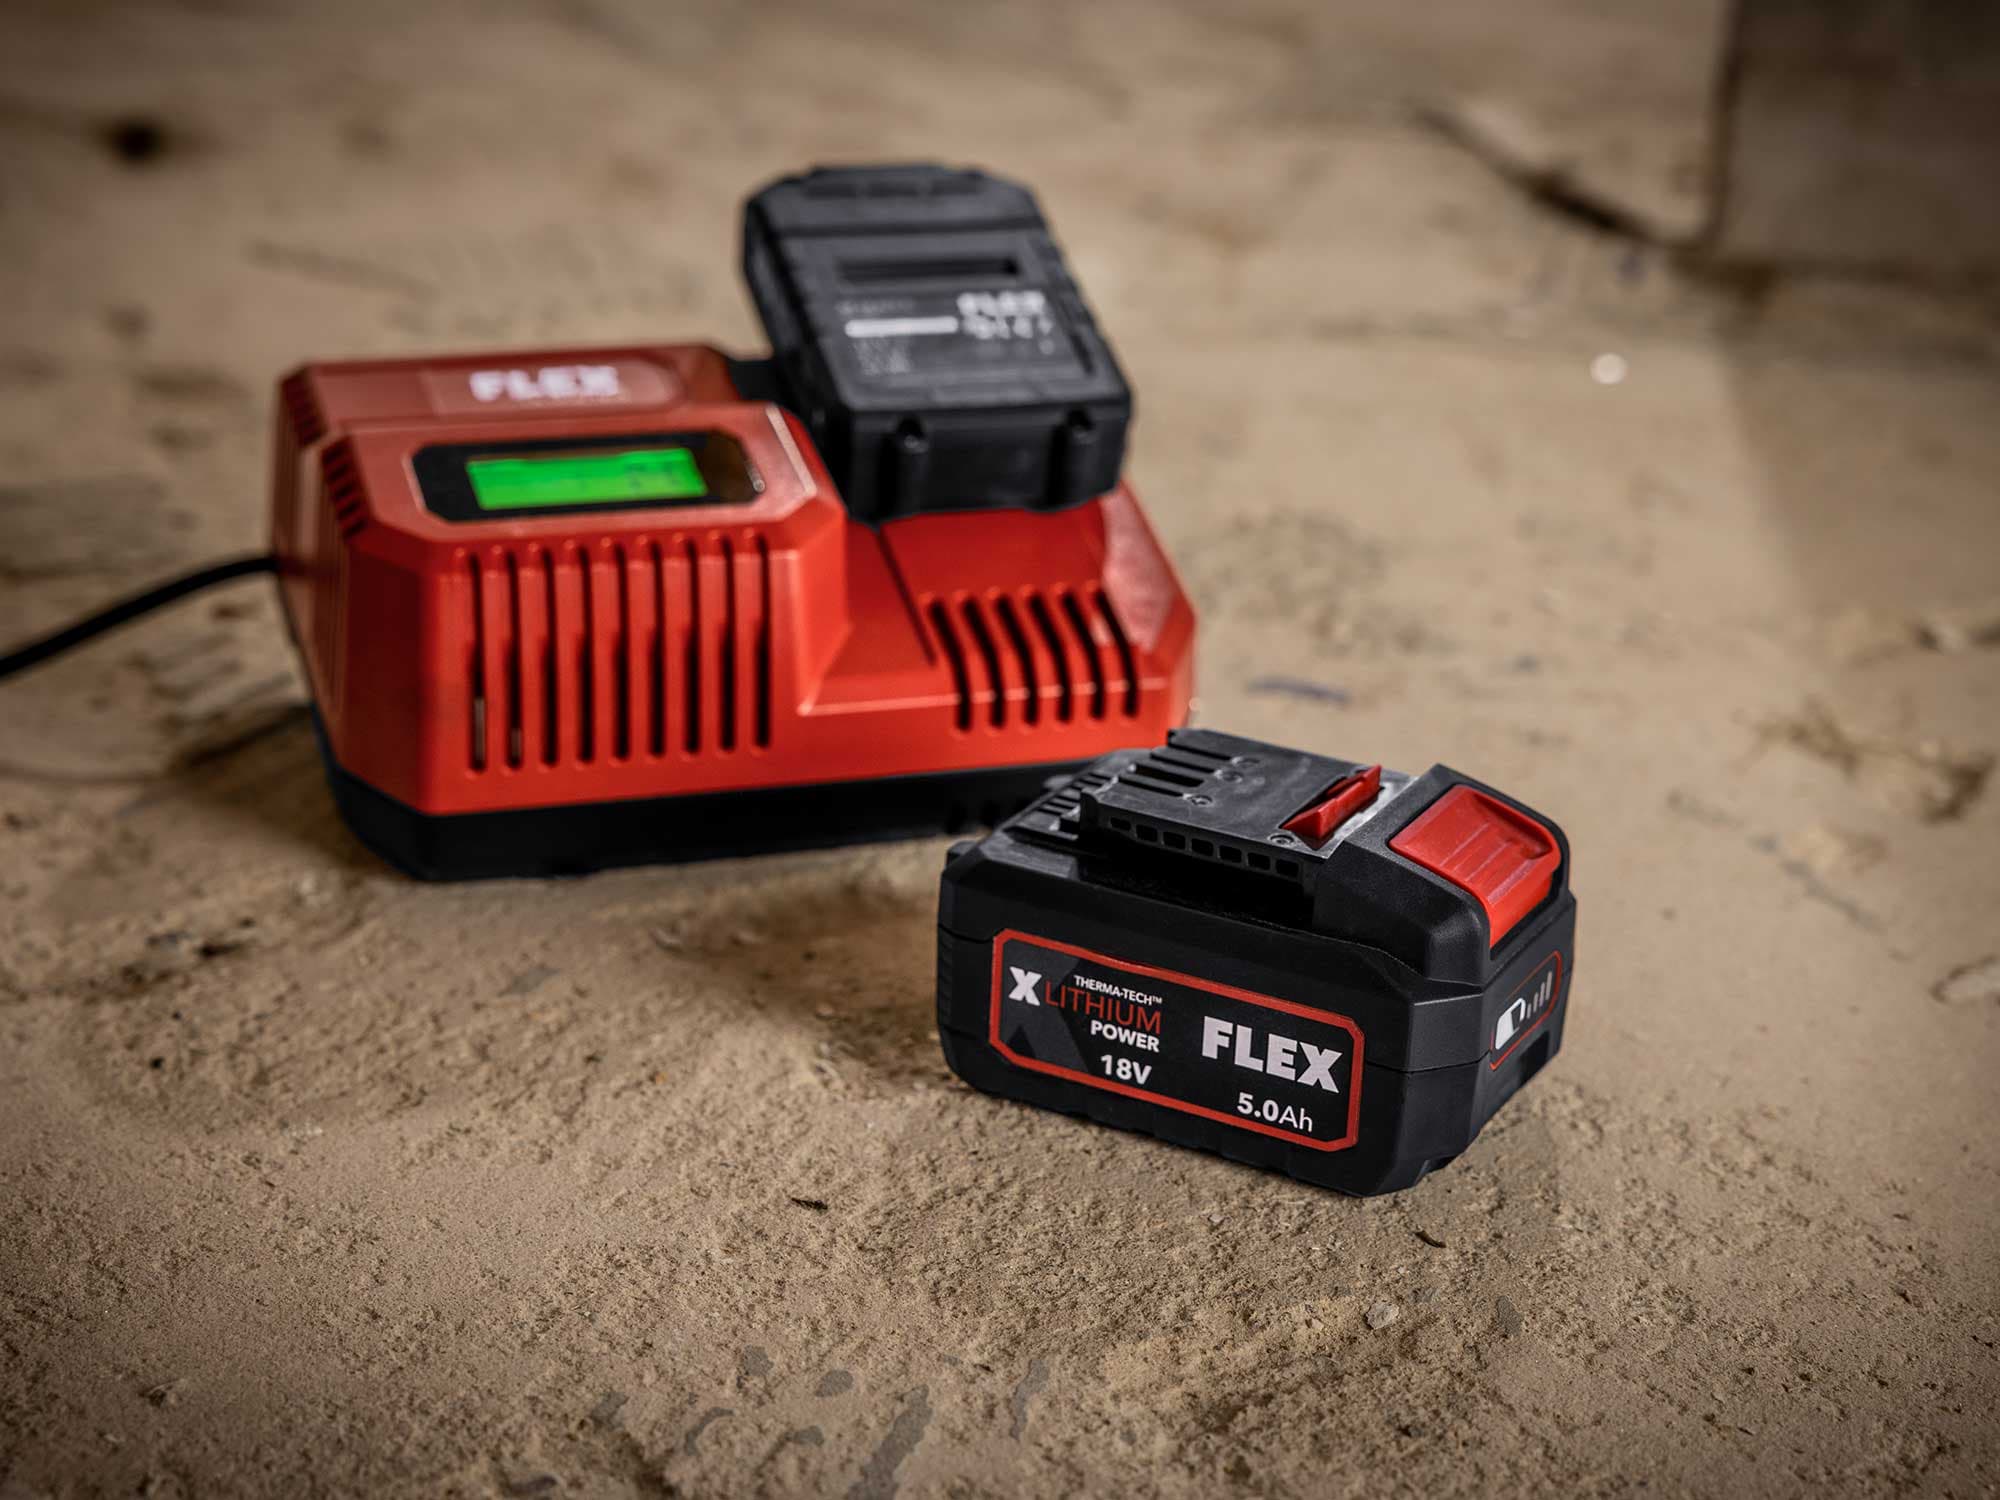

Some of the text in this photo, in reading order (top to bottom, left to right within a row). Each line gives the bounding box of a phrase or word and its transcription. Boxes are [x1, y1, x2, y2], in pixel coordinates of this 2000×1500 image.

[470, 365, 620, 402] FLEX
[1045, 981, 1162, 1035] LITHIUM
[1090, 1019, 1161, 1053] POWER
[1202, 1015, 1344, 1094] FLEX
[1100, 1053, 1153, 1086] 18V
[1237, 1091, 1314, 1133] 5.0Ah
